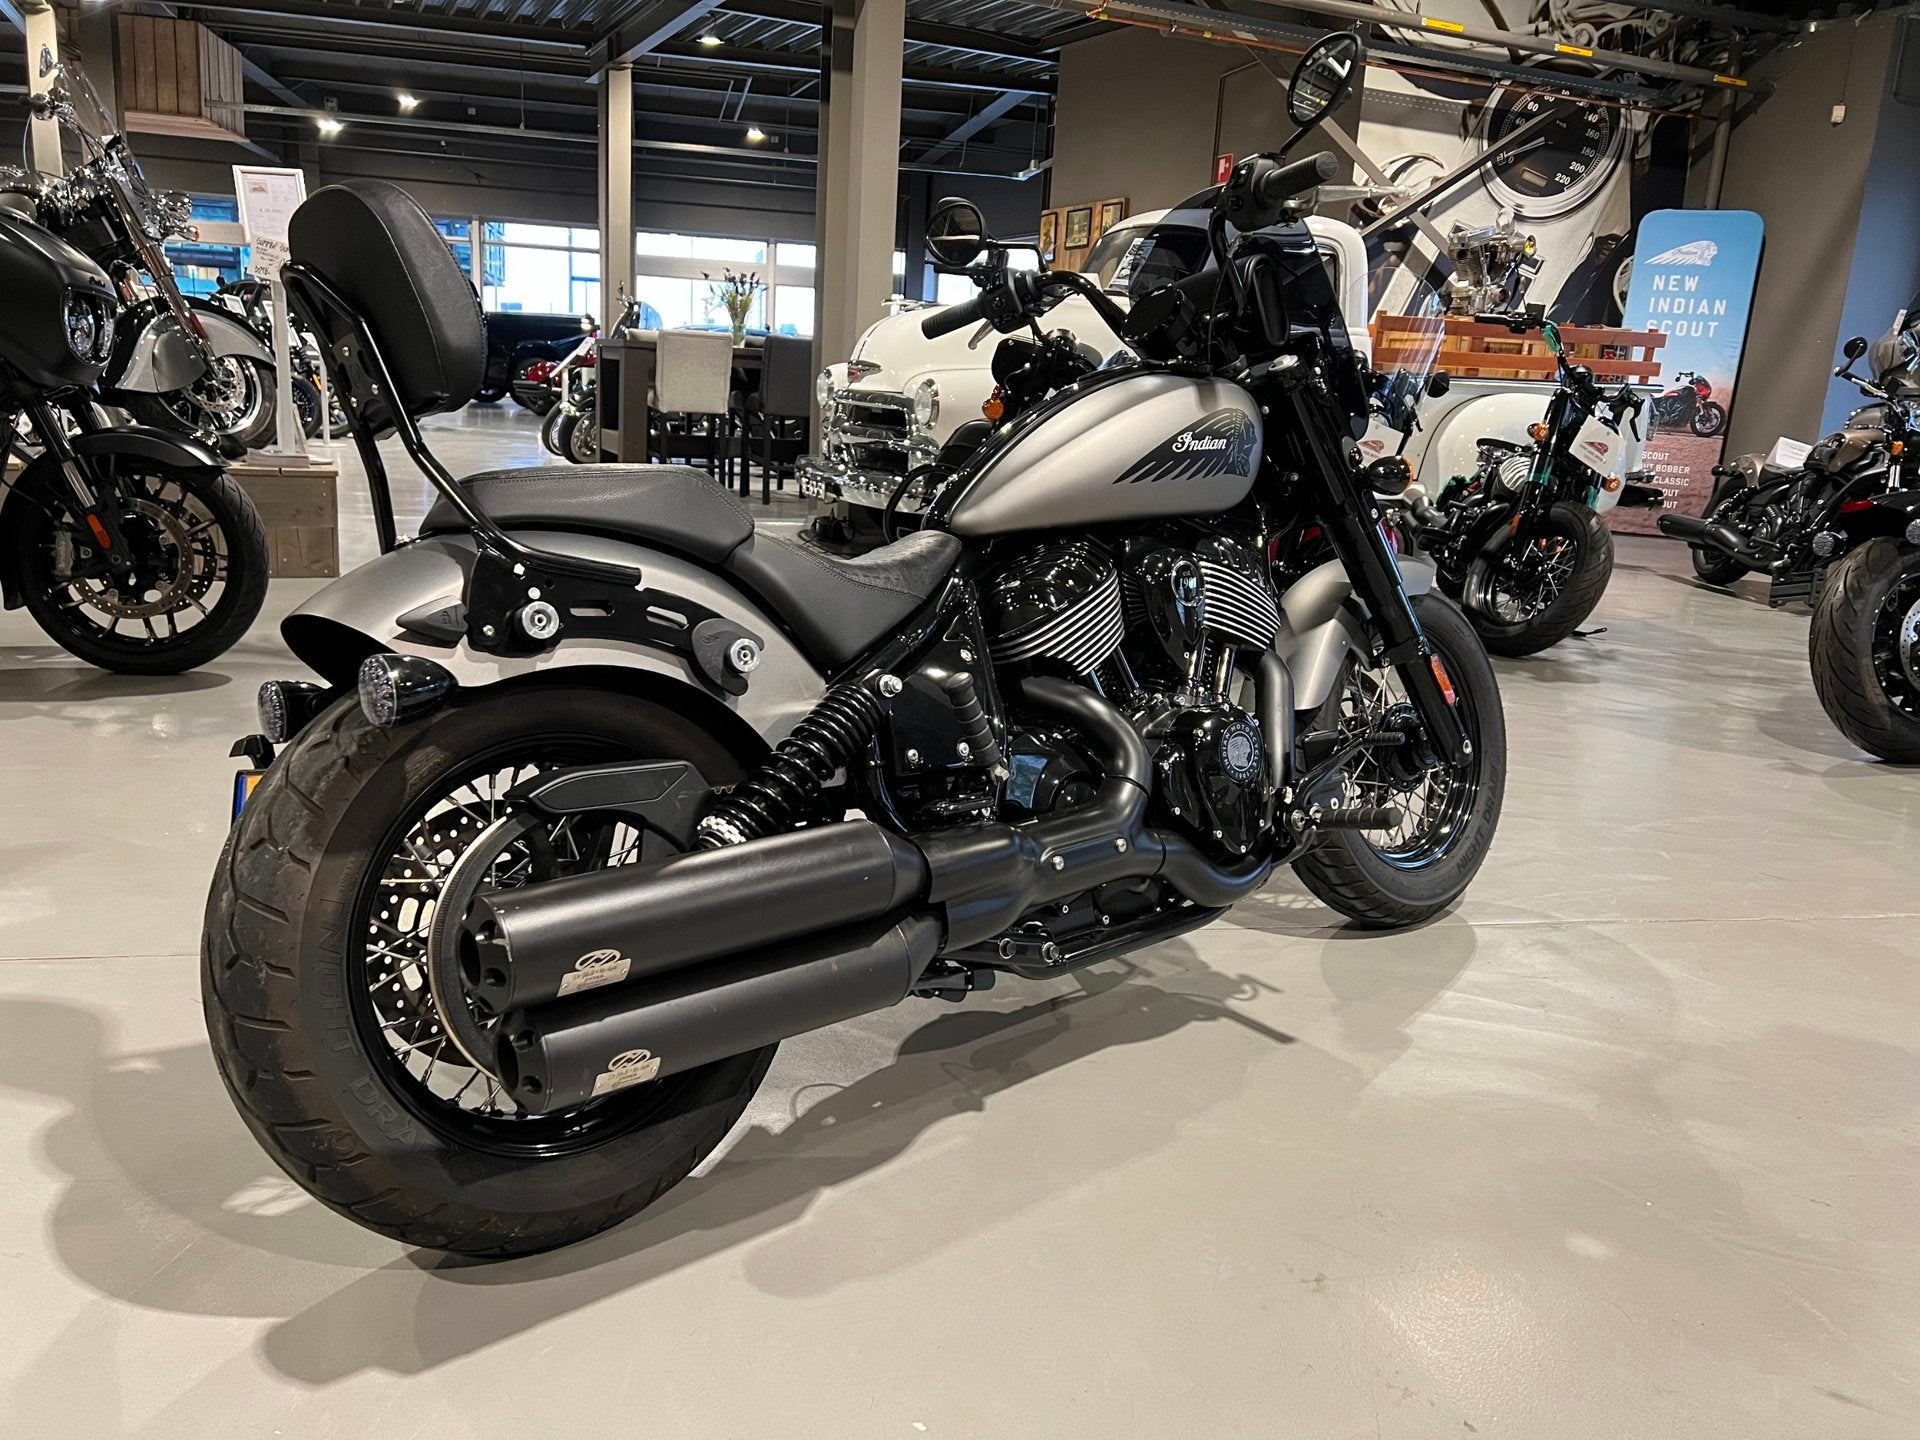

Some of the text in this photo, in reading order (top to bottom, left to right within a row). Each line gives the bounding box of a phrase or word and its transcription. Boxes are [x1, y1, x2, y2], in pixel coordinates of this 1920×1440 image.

[1527, 101, 1539, 112] 60
[1584, 111, 1599, 123] 140
[1585, 128, 1600, 140] 160
[1581, 146, 1595, 158] 180
[1569, 161, 1586, 173] 200
[1554, 172, 1571, 185] 220
[1652, 274, 1699, 292] NEW
[1648, 297, 1727, 315] INDIAN
[1646, 319, 1719, 338] SCOUT
[1172, 431, 1227, 453] Indian
[1641, 452, 1669, 460] SCOUT
[1655, 464, 1690, 474] BOBBER
[1653, 476, 1690, 486] CLASSIC
[1222, 723, 1259, 770] INDIAN MOTORCYCLE
[1456, 827, 1485, 873] NIGHT
